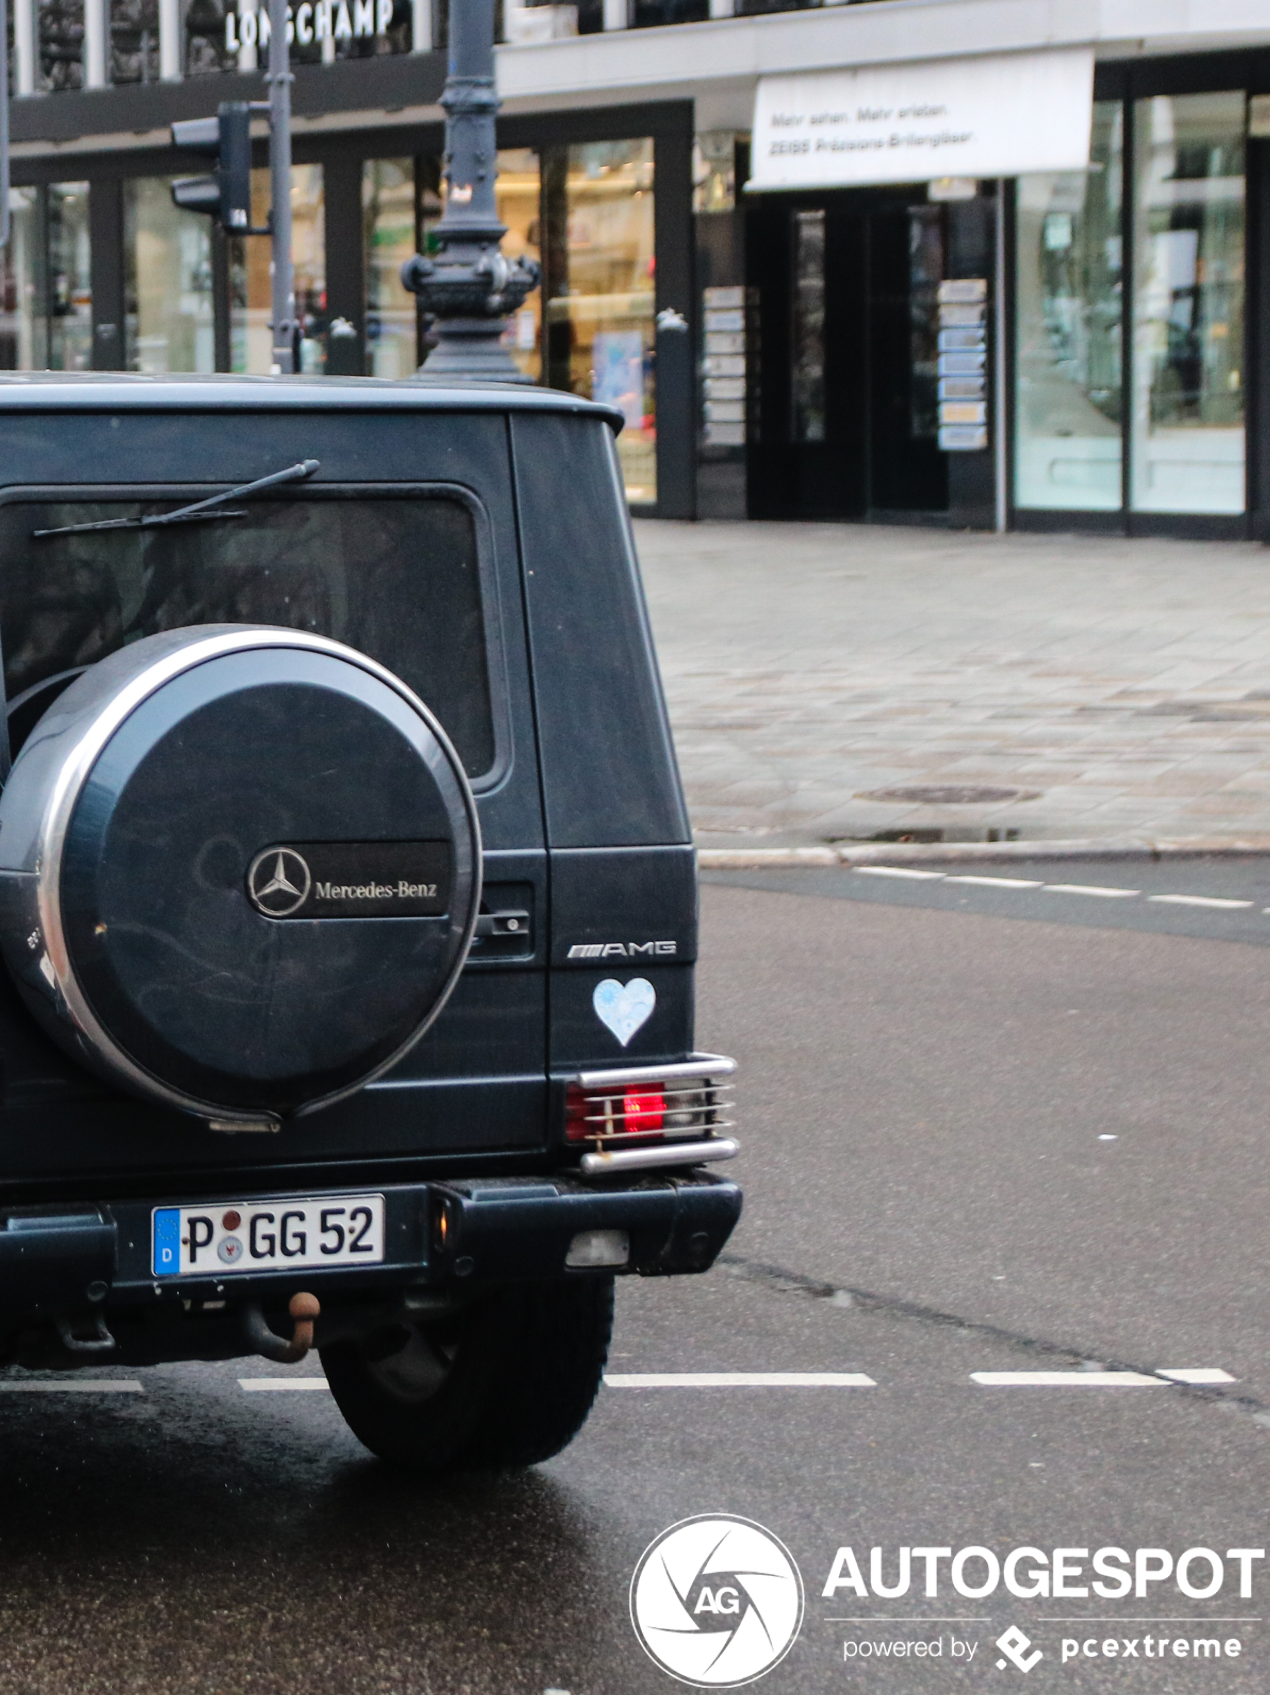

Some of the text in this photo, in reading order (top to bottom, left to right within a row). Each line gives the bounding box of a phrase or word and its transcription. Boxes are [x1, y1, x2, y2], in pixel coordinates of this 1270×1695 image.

[315, 881, 437, 899] Mercedes-Benz
[601, 940, 677, 957] AMG
[186, 1216, 214, 1263] P
[319, 1206, 374, 1255] 52
[162, 1248, 172, 1263] D
